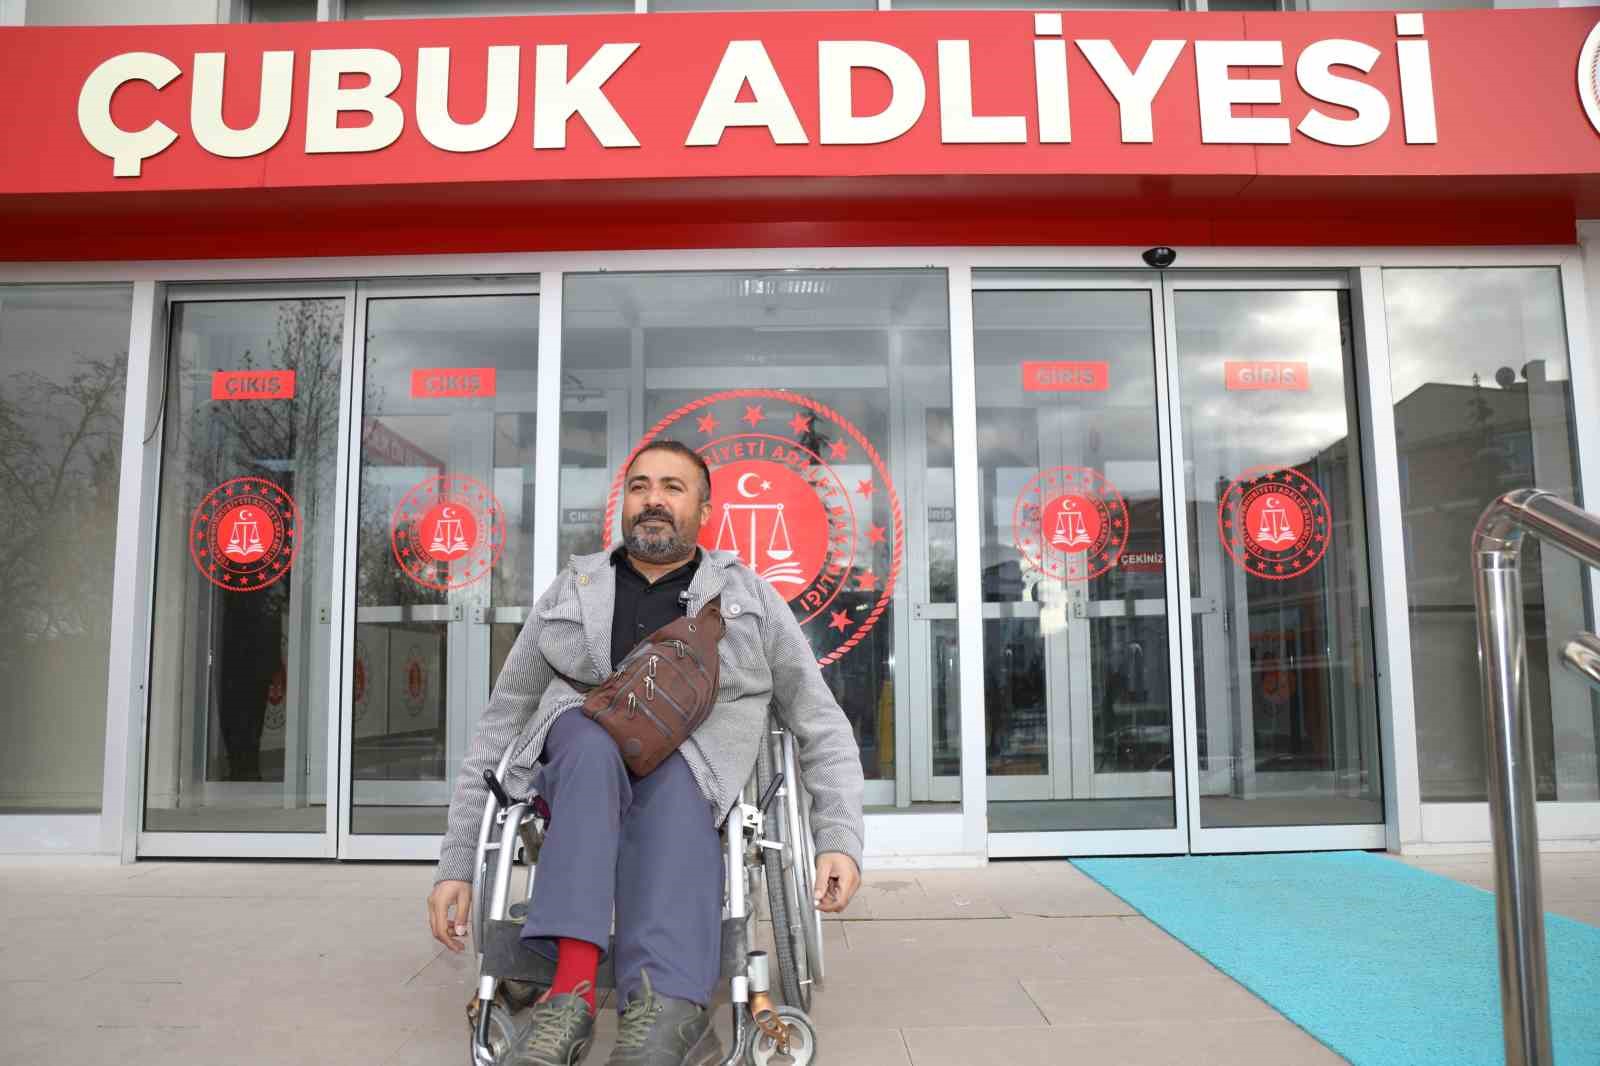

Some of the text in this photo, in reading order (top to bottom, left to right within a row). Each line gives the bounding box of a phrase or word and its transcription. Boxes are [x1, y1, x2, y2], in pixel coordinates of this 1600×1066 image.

[77, 12, 1438, 178] ÇUBUK ADLİYESİ
[1120, 552, 1164, 565] ÇEKİNİZ
